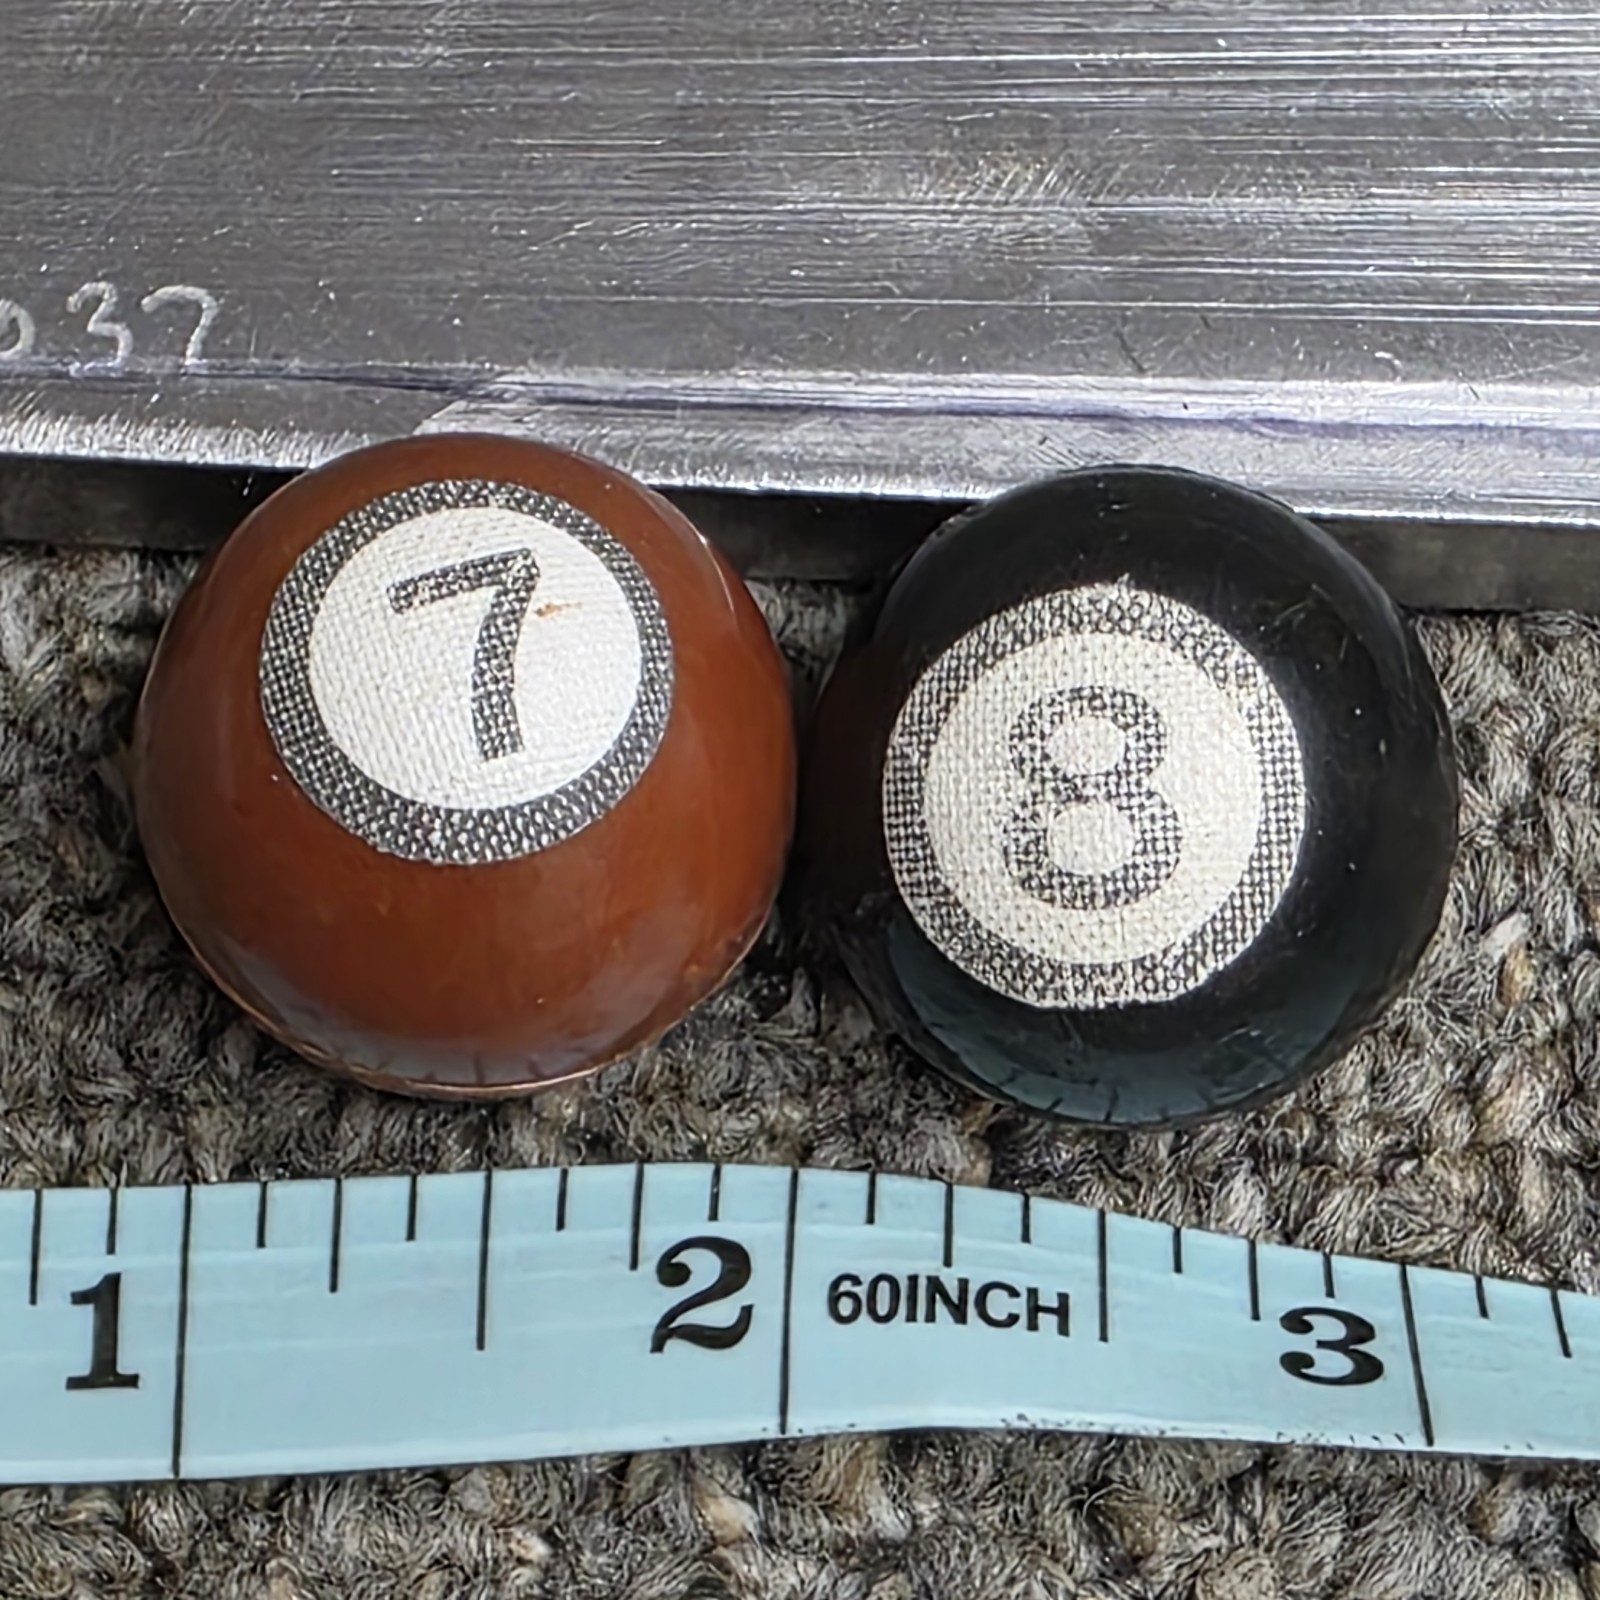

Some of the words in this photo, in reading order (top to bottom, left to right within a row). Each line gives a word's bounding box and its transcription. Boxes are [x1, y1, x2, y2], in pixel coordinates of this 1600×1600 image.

[386, 547, 541, 762] 7
[1003, 685, 1181, 911] 8
[66, 1272, 139, 1390] 1
[650, 1236, 754, 1354] 2
[827, 1273, 1070, 1338] 60INCH
[1279, 1307, 1384, 1386] 3
